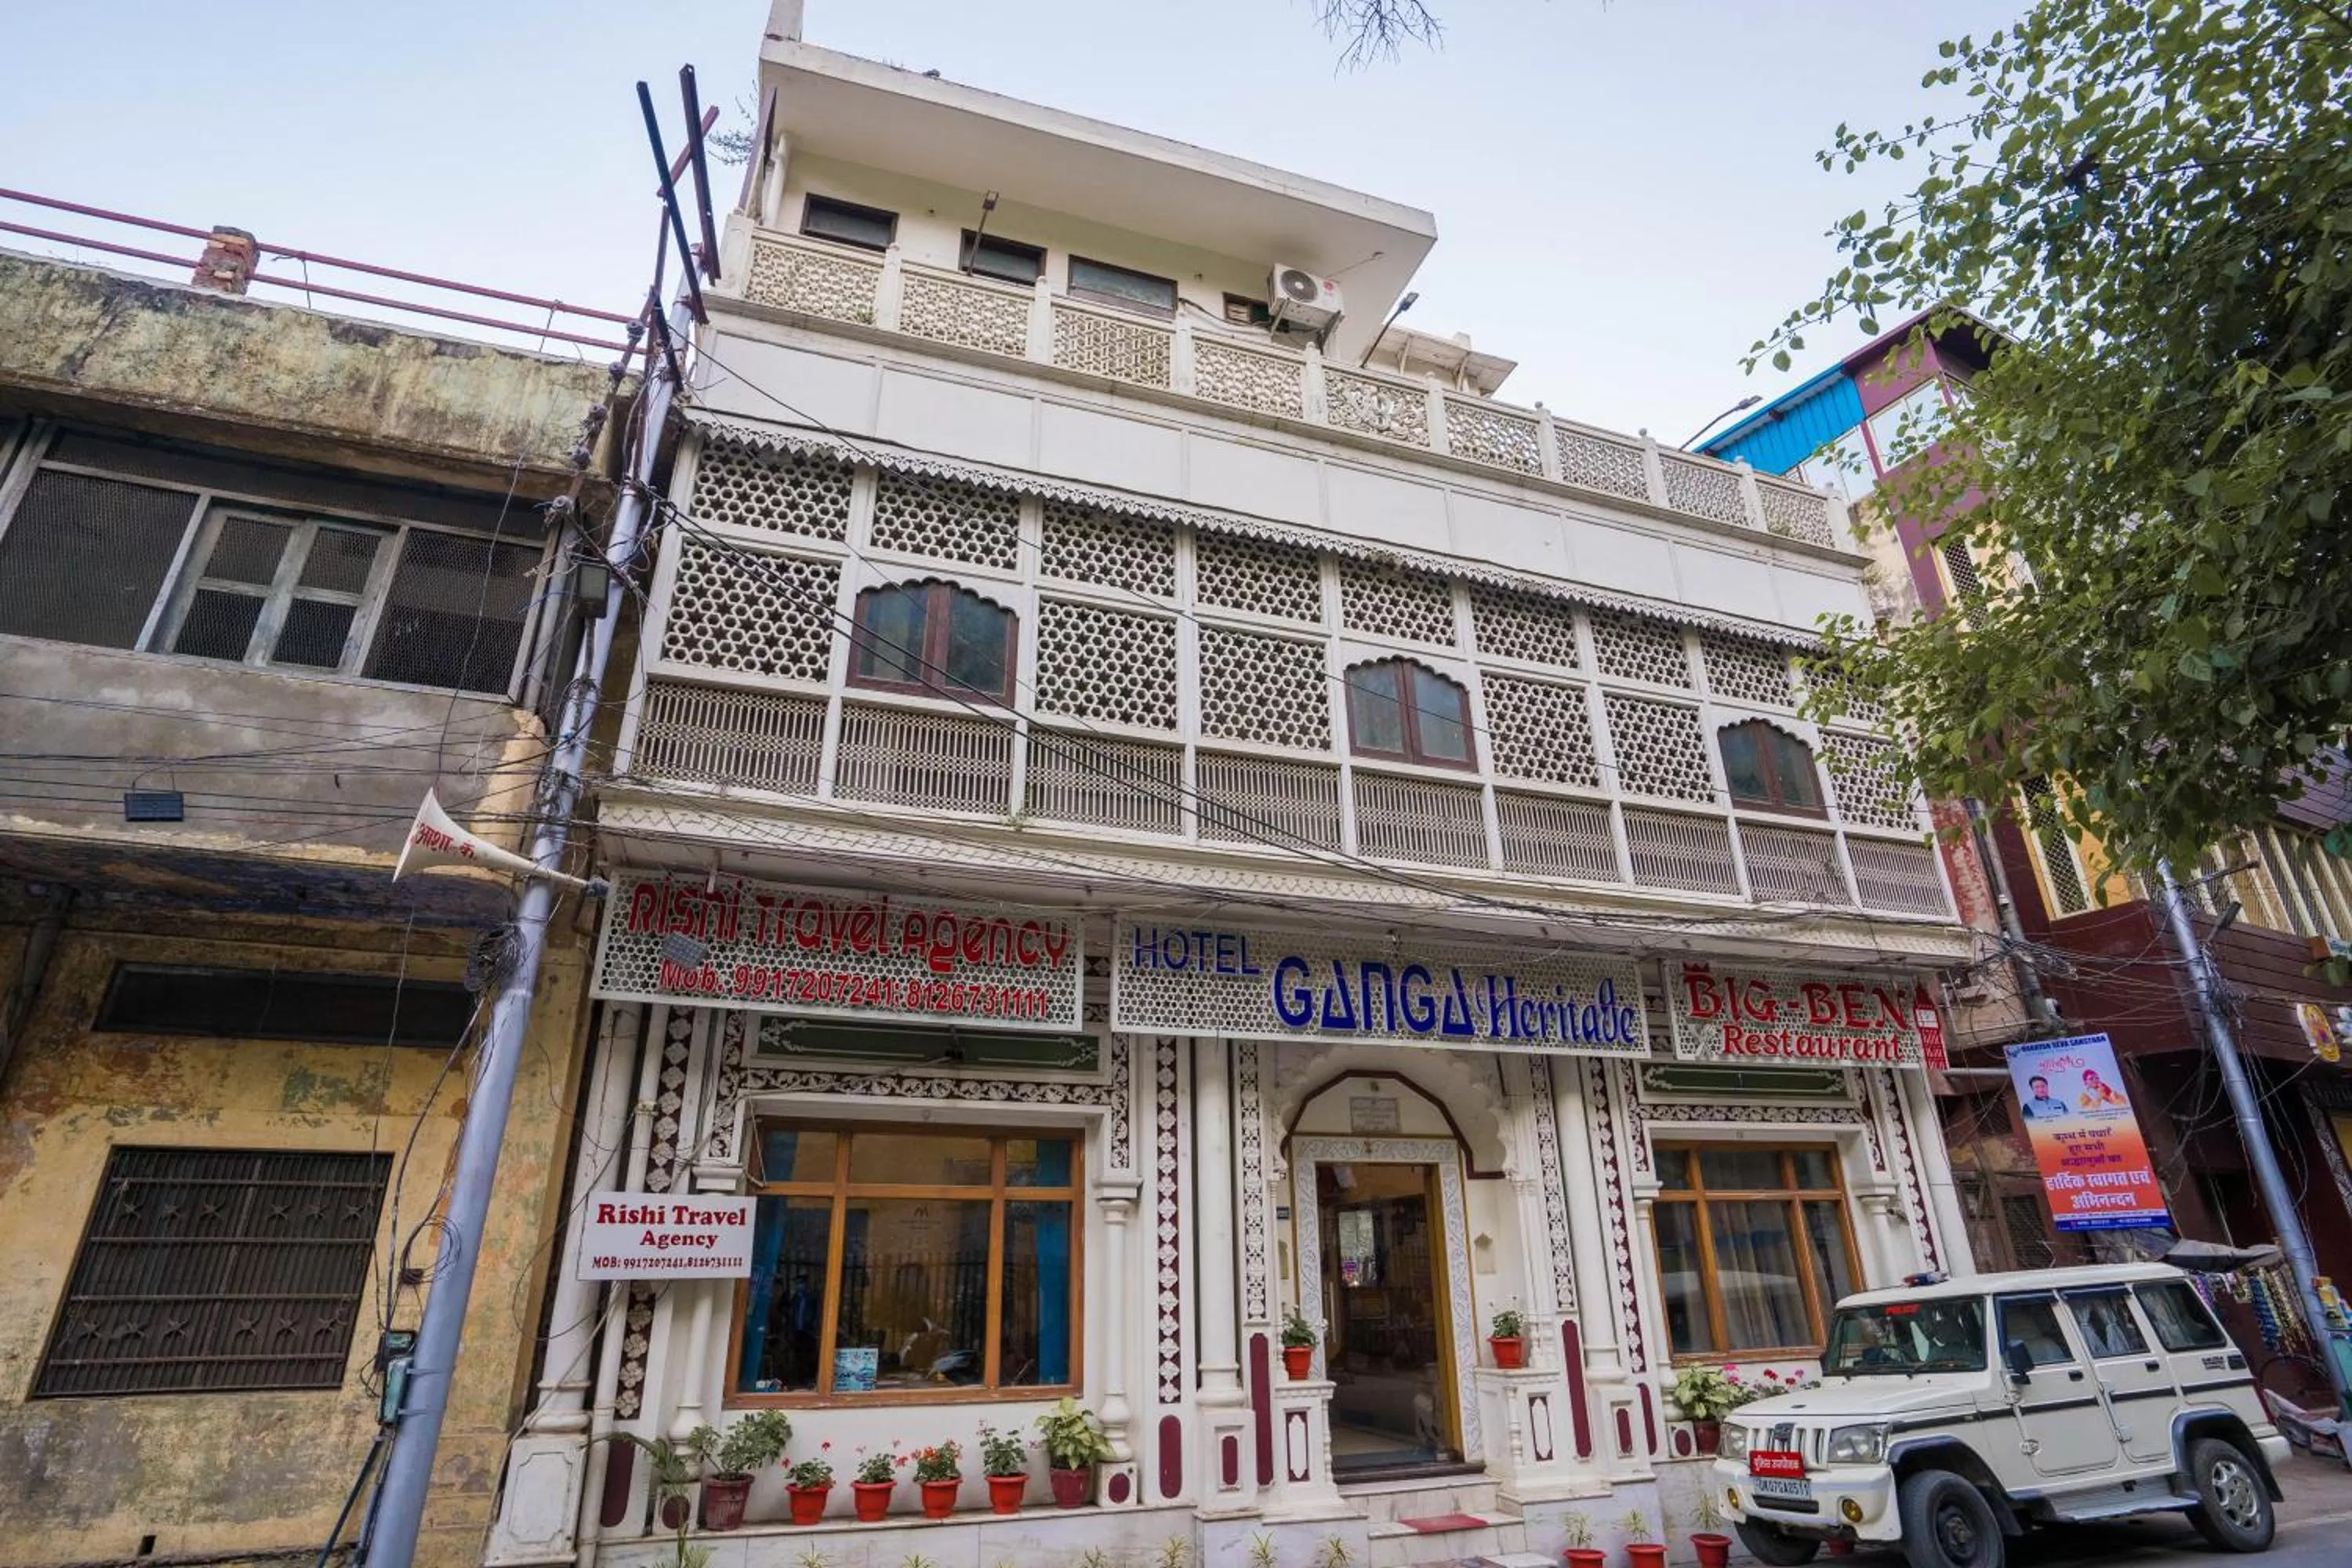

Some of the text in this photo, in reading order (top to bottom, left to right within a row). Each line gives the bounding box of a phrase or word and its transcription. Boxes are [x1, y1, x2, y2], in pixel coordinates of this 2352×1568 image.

[1131, 927, 1260, 975] HOTEL
[1273, 956, 1475, 1035] GANGA
[1722, 1025, 1903, 1062] Restaurant
[597, 1203, 746, 1225] Rishi Travel
[640, 1230, 718, 1249] Agency
[592, 1256, 621, 1269] MOB:
